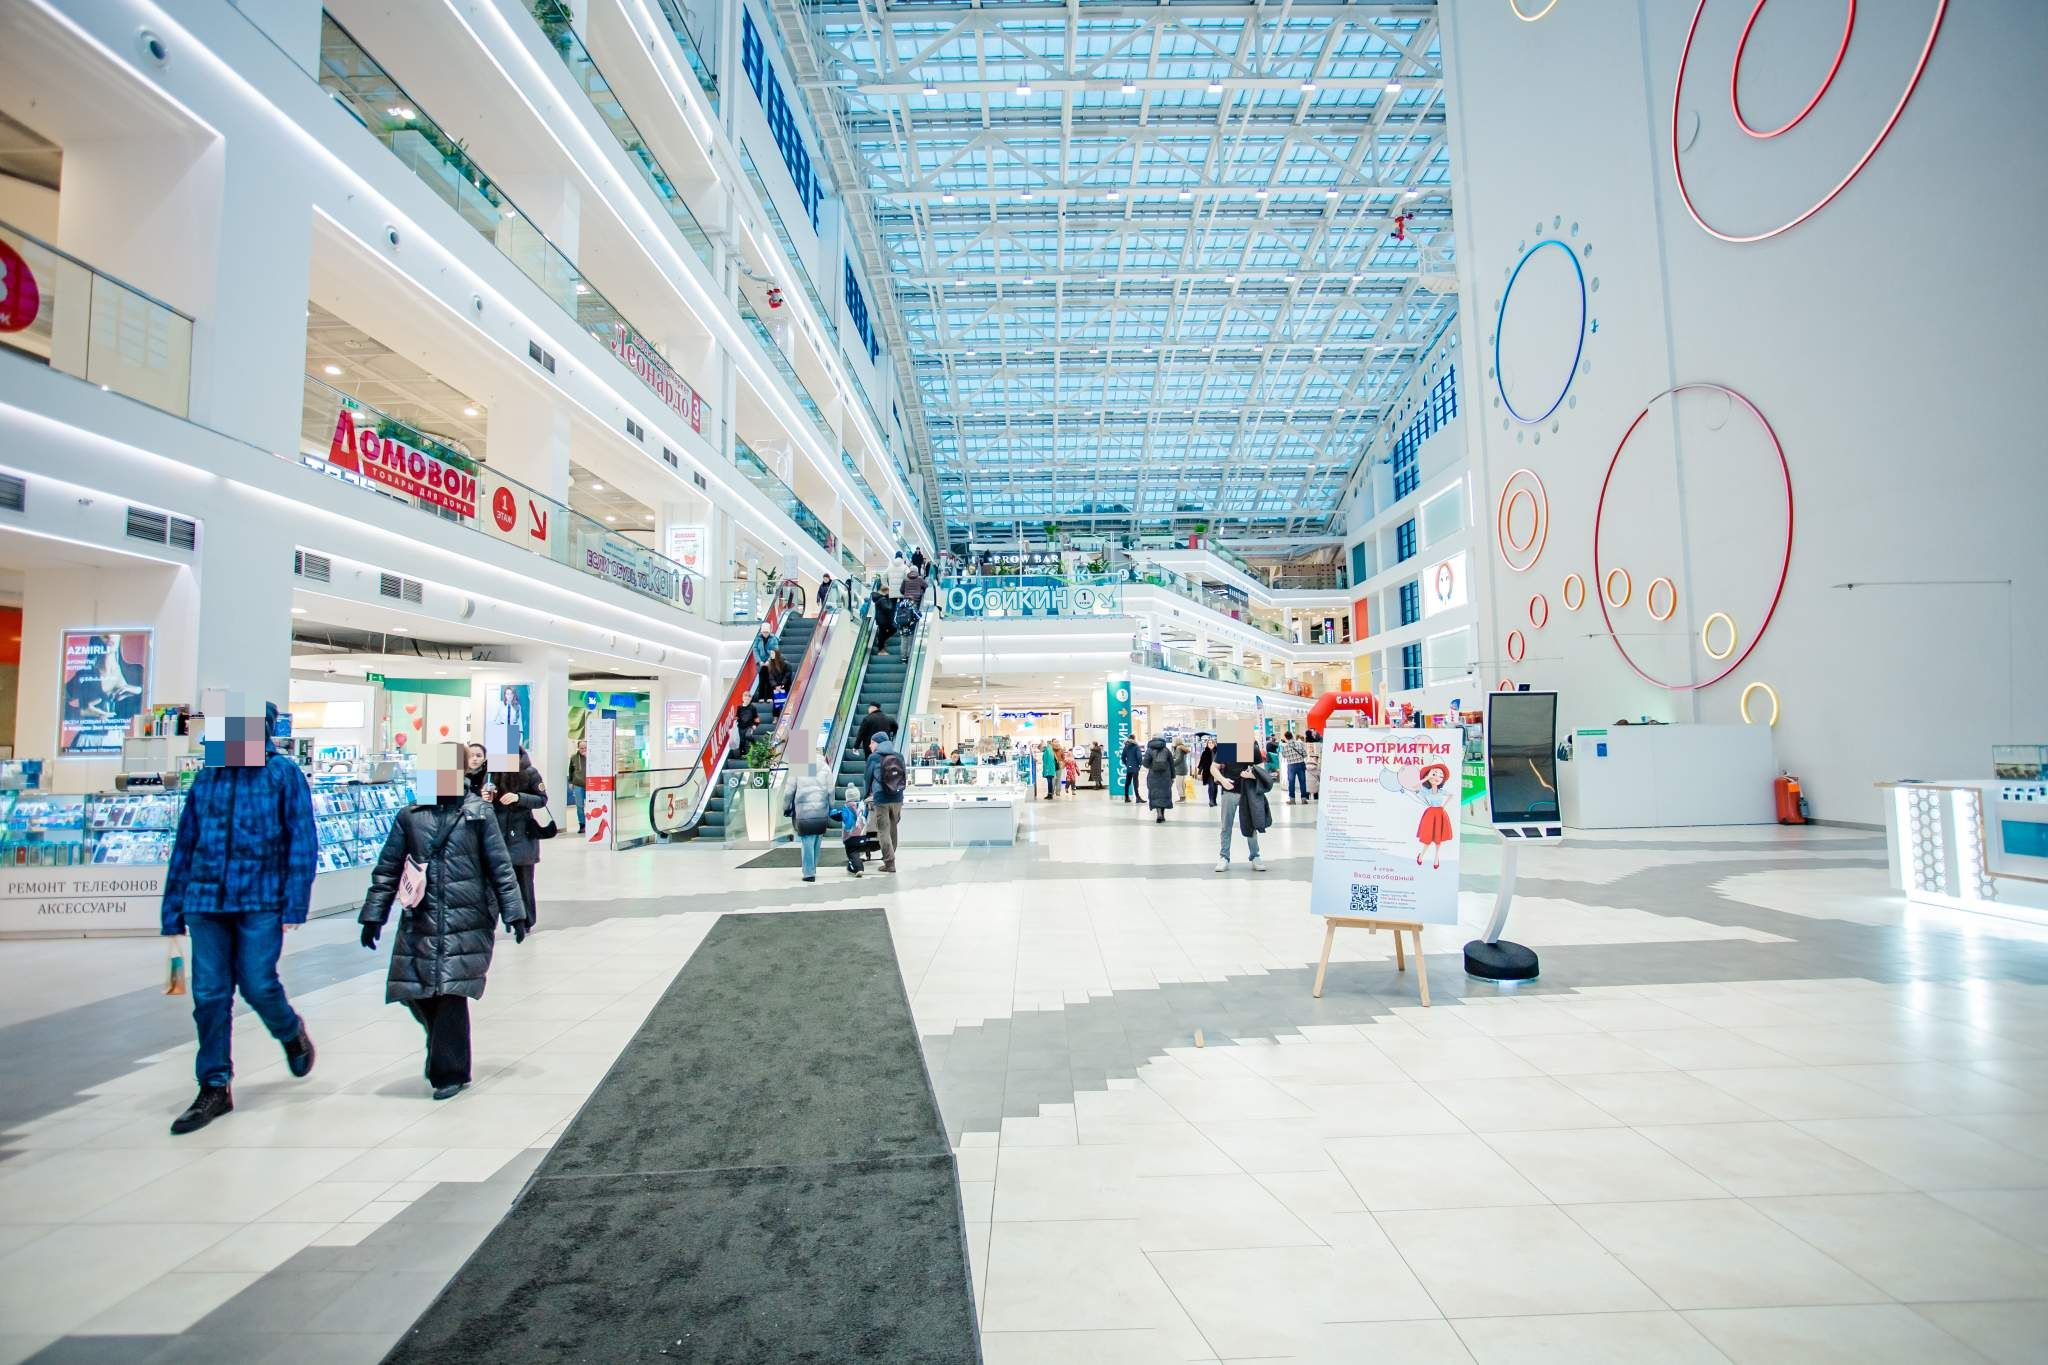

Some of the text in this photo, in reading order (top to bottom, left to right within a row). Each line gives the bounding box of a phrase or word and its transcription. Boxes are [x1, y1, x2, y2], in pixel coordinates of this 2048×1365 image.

[611, 323, 689, 418] Леонардо
[693, 399, 699, 420] 3
[372, 468, 415, 491] ТОВАРЫ
[419, 487, 438, 501] ДЛЯ
[443, 495, 468, 513] ДОМА
[501, 495, 507, 509] 1
[496, 511, 513, 525] ЭТАЖ
[586, 549, 609, 574] ЕСЛИ
[948, 586, 1087, 611] Обойкин 1
[1336, 695, 1369, 705] Gokart
[1332, 742, 1451, 754] МЕРОПРИЯТИЯ
[1356, 757, 1363, 765] в
[1366, 756, 1390, 765] ТРК
[1329, 775, 1379, 784] Расписание
[667, 793, 675, 819] 3
[1372, 872, 1415, 881] свободный
[8, 879, 158, 894] РЕМОНТ ТЕЛЕФОНОВ
[38, 901, 127, 915] АКСЕССУАРЫ
